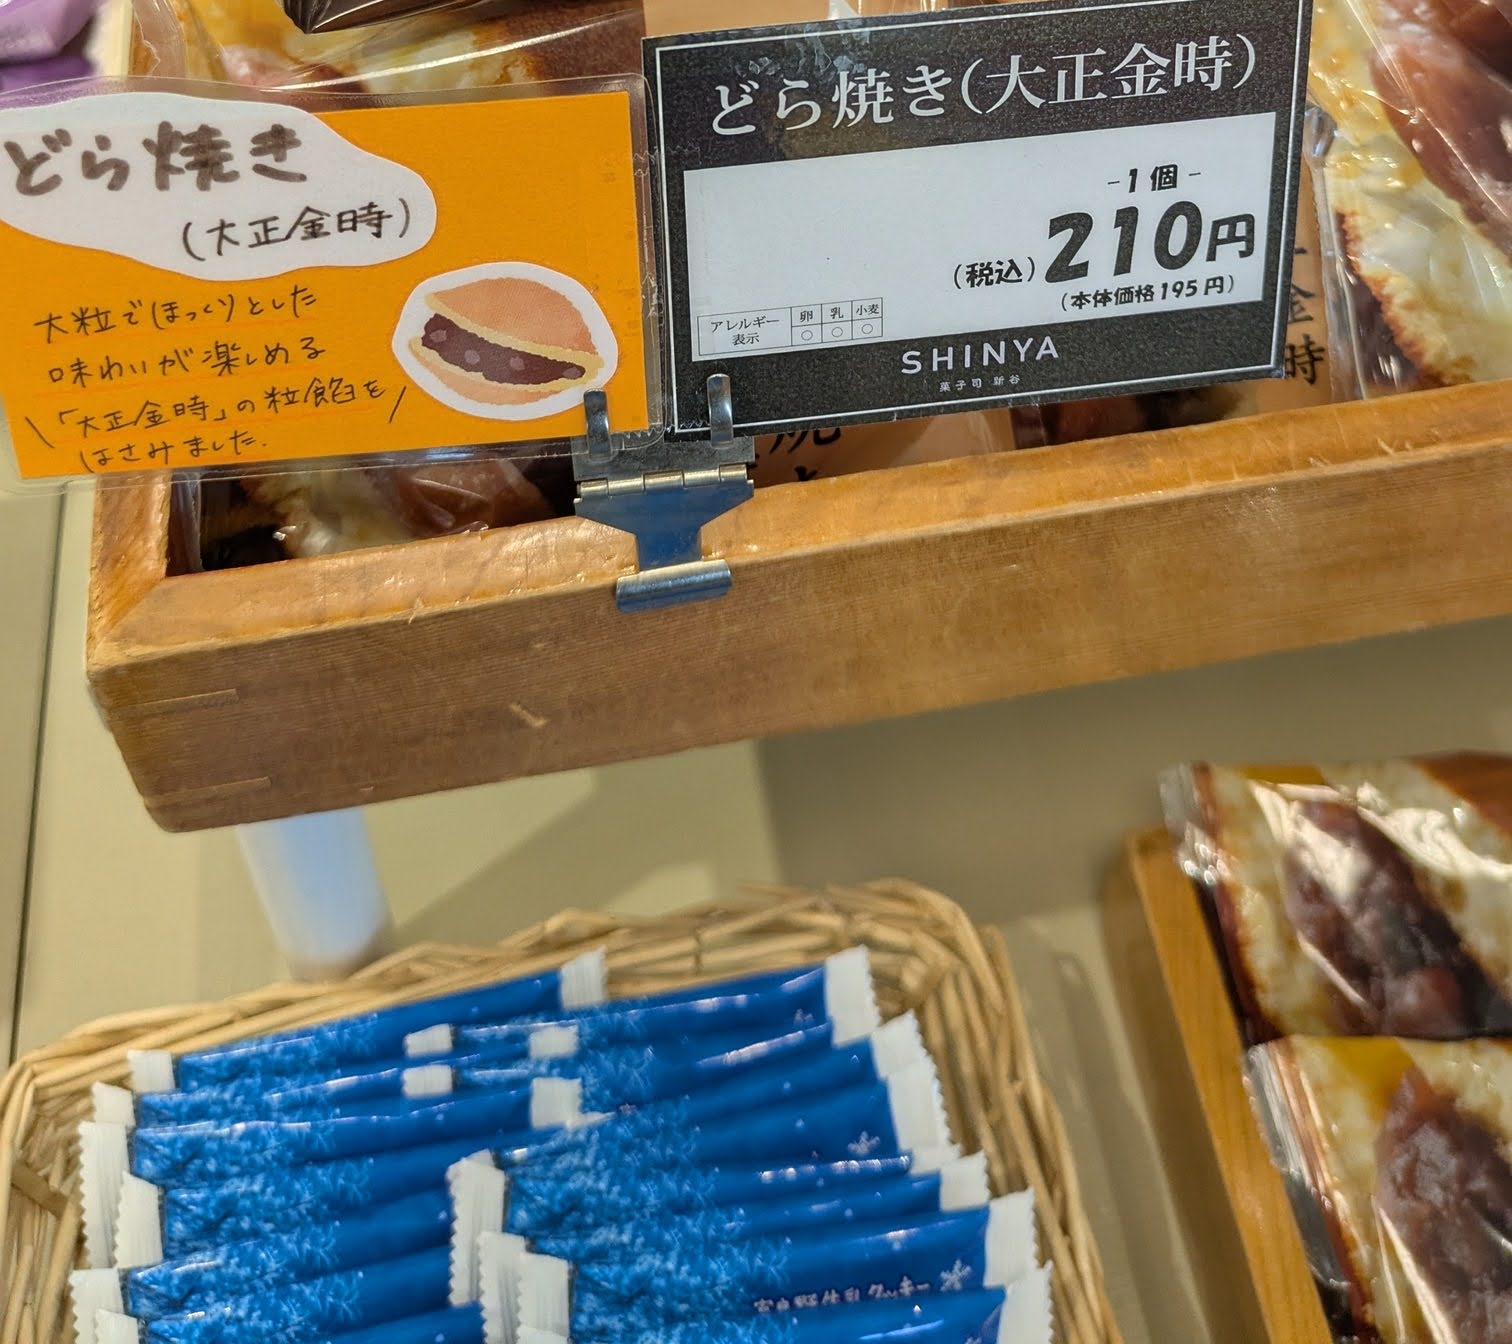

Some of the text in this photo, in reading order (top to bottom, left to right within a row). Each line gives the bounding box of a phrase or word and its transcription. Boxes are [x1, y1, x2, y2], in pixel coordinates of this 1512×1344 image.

[711, 33, 1256, 136] どら焼き(大正金時)
[4, 121, 307, 196] どら焼き
[182, 198, 411, 261] (大正金時)
[34, 285, 317, 344] 大粒でほっくりとした
[711, 315, 780, 334] アレルギー
[799, 310, 814, 323] 卵
[830, 307, 844, 320] 乳
[855, 303, 880, 316] 小麦
[732, 333, 760, 346] 表示
[901, 336, 1059, 374] SHINYA
[48, 337, 326, 387] 味わいが楽しめる
